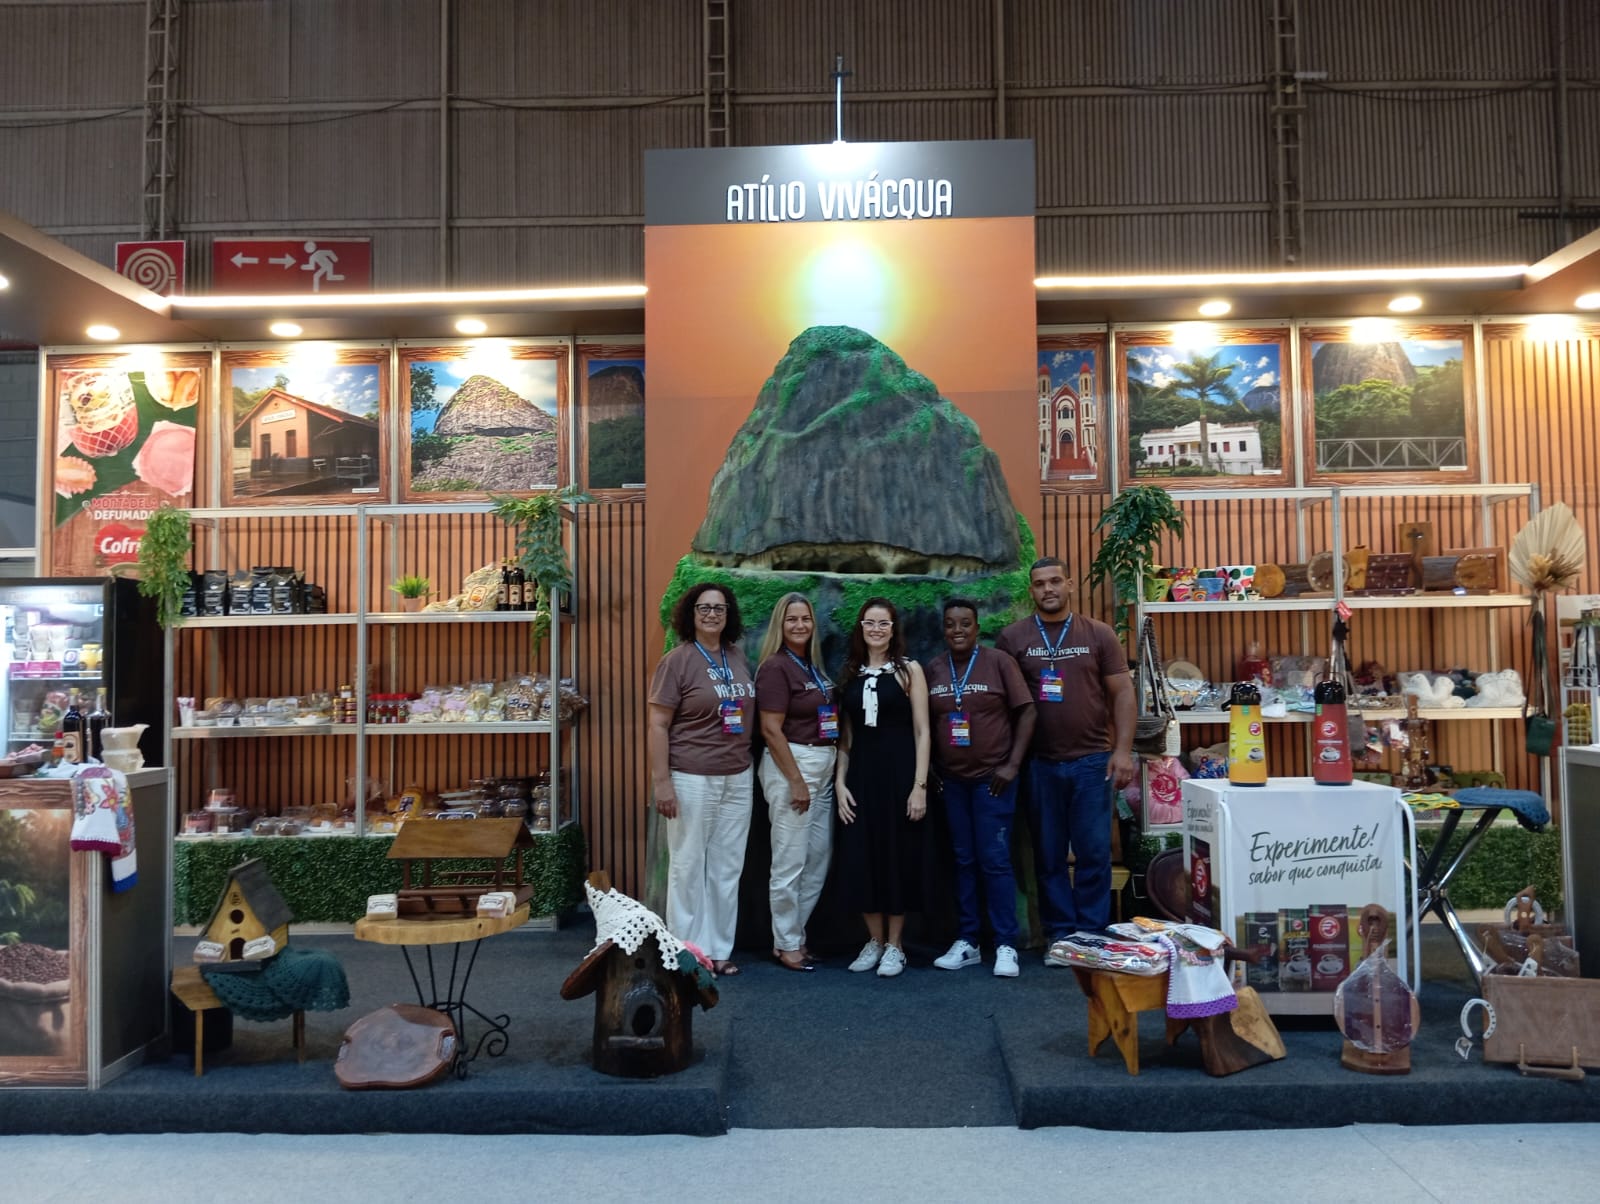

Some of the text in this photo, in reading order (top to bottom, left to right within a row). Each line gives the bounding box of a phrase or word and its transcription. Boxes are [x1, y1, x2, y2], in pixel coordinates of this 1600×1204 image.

[726, 169, 953, 222] ATÍLIO VIVÁCQUA
[92, 497, 159, 509] MORTADELA
[1249, 822, 1380, 867] Experimente!
[1248, 853, 1382, 886] sabor que conquista
